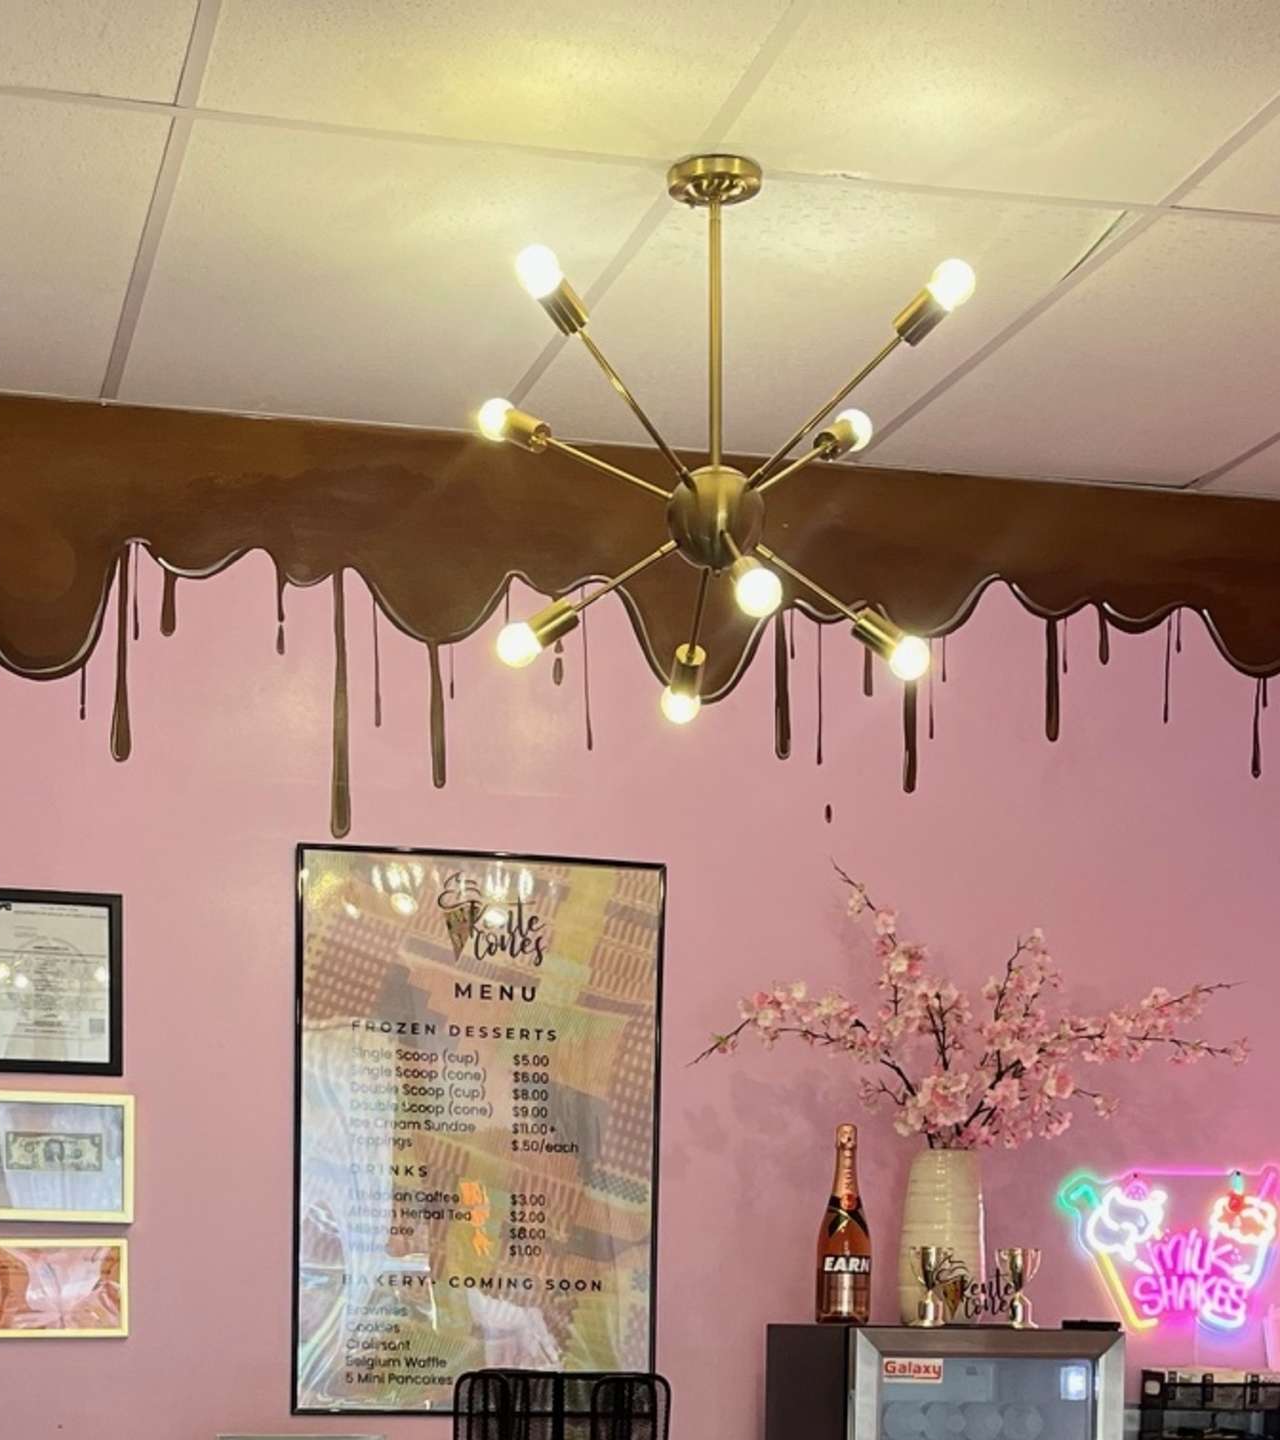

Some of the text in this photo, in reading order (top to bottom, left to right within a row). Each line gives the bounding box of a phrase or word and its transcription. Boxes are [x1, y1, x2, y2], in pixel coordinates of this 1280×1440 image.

[468, 896, 546, 938] Kte
[454, 983, 536, 1002] MENU
[351, 1021, 558, 1042] FROZEN DESSERTS
[395, 1049, 439, 1064] Scoop
[443, 1048, 479, 1066] (cup)
[513, 1054, 550, 1067] $5.00
[395, 1066, 439, 1082] Scoop
[442, 1066, 487, 1083] (cone)
[402, 1083, 444, 1099] Scoop
[449, 1083, 486, 1100] (cup)
[512, 1088, 549, 1101] $8.00
[402, 1100, 444, 1116] Scoop
[449, 1100, 494, 1118] (cone)
[512, 1106, 548, 1118] $9.00
[424, 1119, 476, 1132] Sundae
[350, 1163, 429, 1178] DRINKS
[415, 1190, 460, 1203] Coffee
[509, 1194, 546, 1206] $3.00
[401, 1207, 444, 1220] Herbal
[448, 1208, 472, 1221] Tea
[509, 1211, 546, 1223] $2.00
[509, 1245, 542, 1257] $1.00
[1147, 1228, 1234, 1276] MILK
[449, 1275, 533, 1290] COMING
[545, 1279, 602, 1292] SOON
[1133, 1275, 1247, 1316] SHAKES
[346, 1355, 447, 1370] Belgium Waffle
[884, 1361, 942, 1379] Galaxy
[357, 1373, 384, 1384] Mini
[388, 1373, 454, 1385] Pancakes
